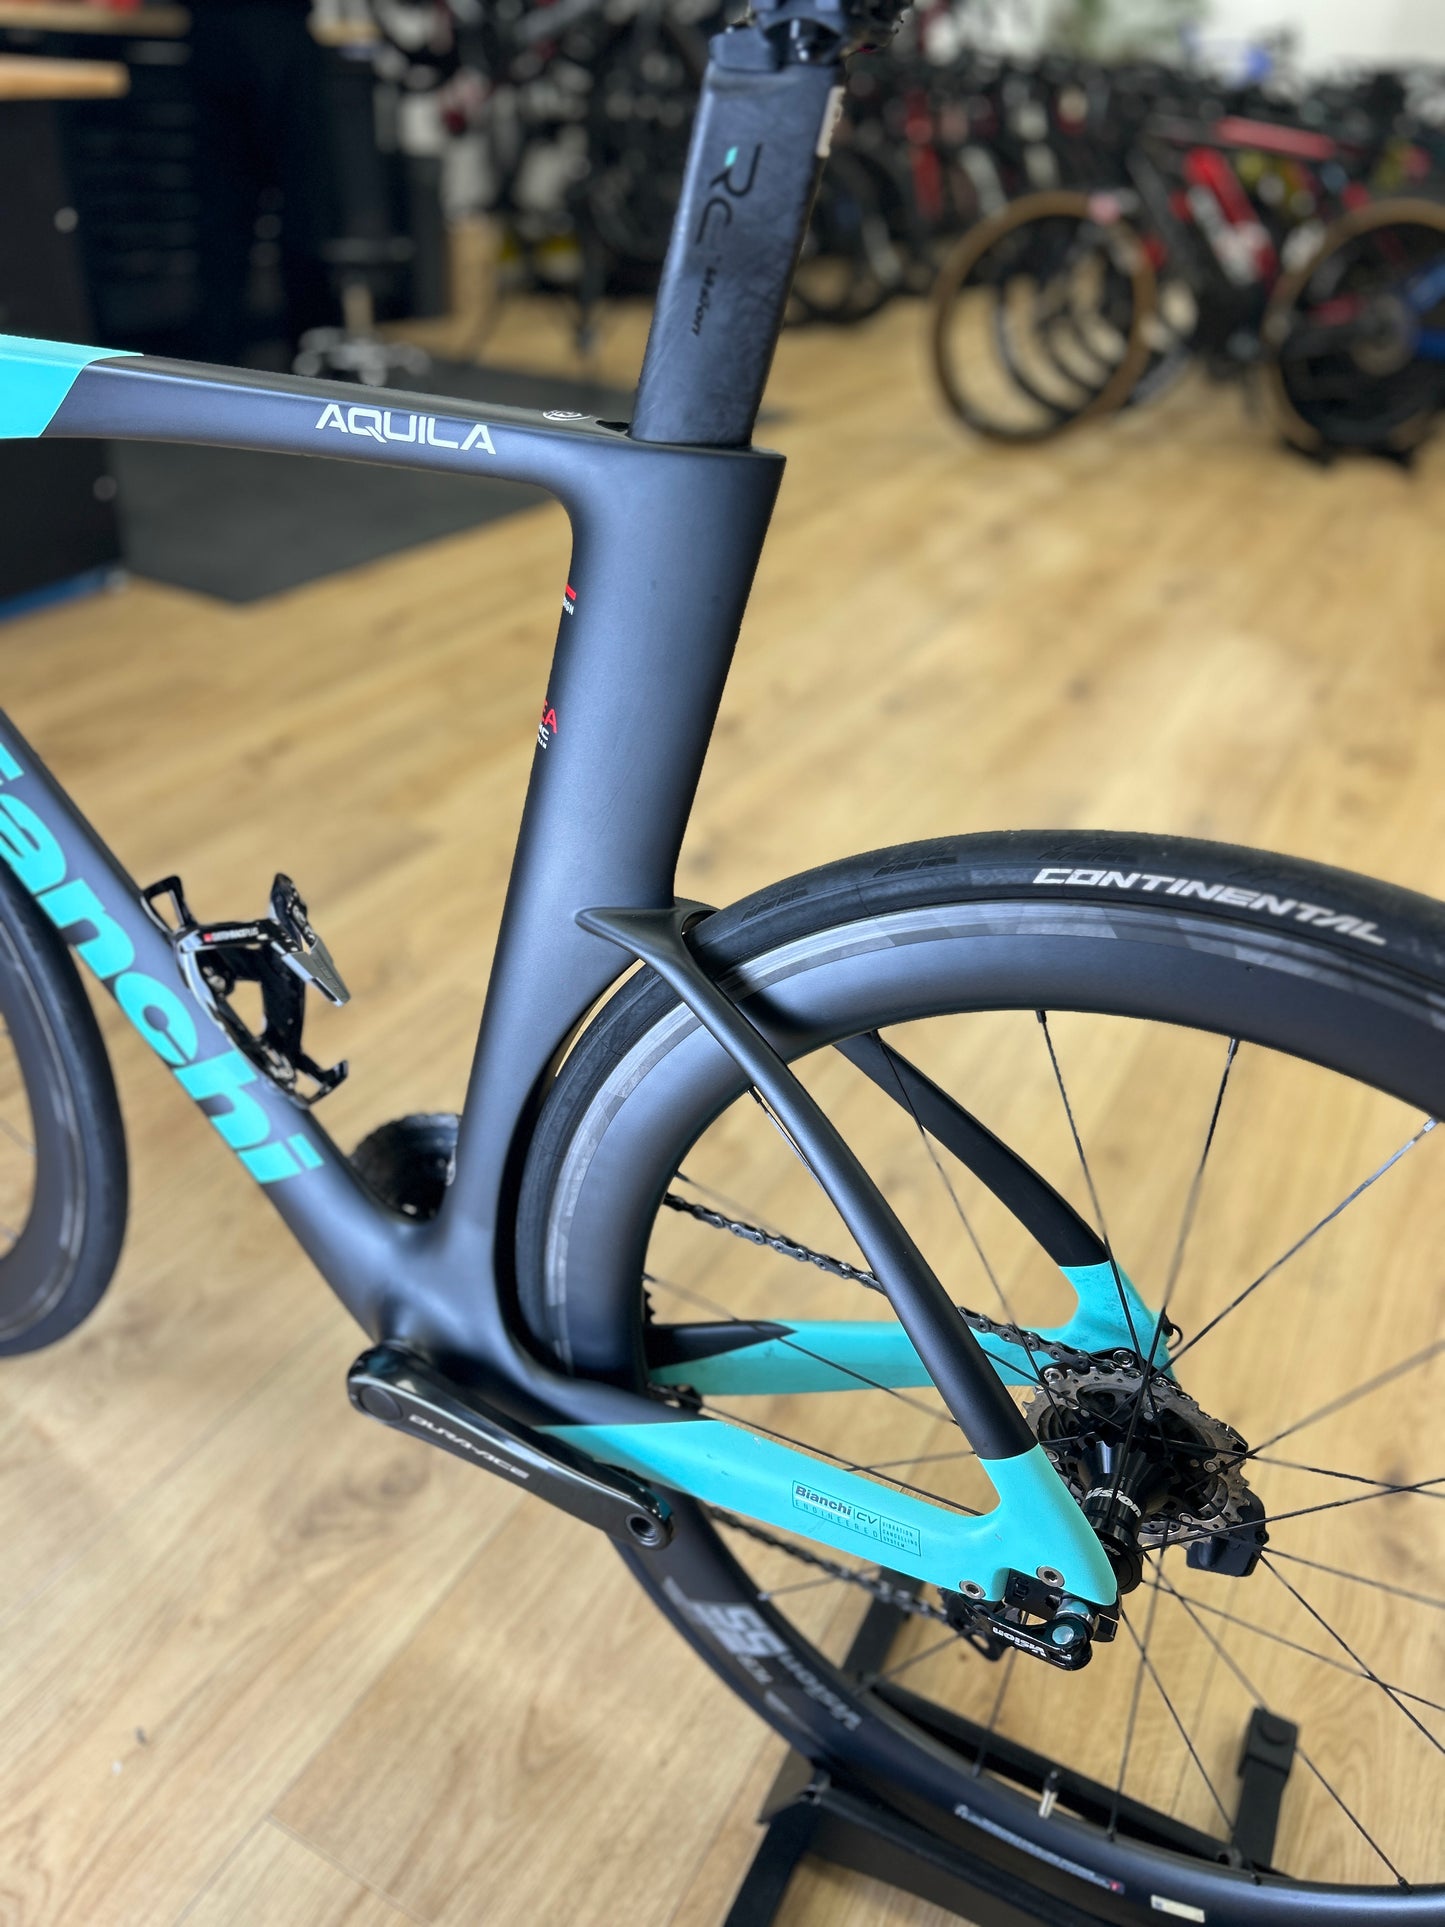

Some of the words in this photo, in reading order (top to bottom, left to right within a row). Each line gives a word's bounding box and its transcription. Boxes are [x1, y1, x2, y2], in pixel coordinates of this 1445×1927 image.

[315, 403, 497, 455] AQUILA
[1032, 868, 1388, 946] CONTINENTAL
[0, 743, 324, 1184] anchi
[795, 1485, 852, 1516] Bianchi
[856, 1511, 878, 1525] CV
[795, 1500, 878, 1538] ENGINEERED
[882, 1521, 913, 1537] VIBRATION
[992, 1626, 1047, 1658] Vision
